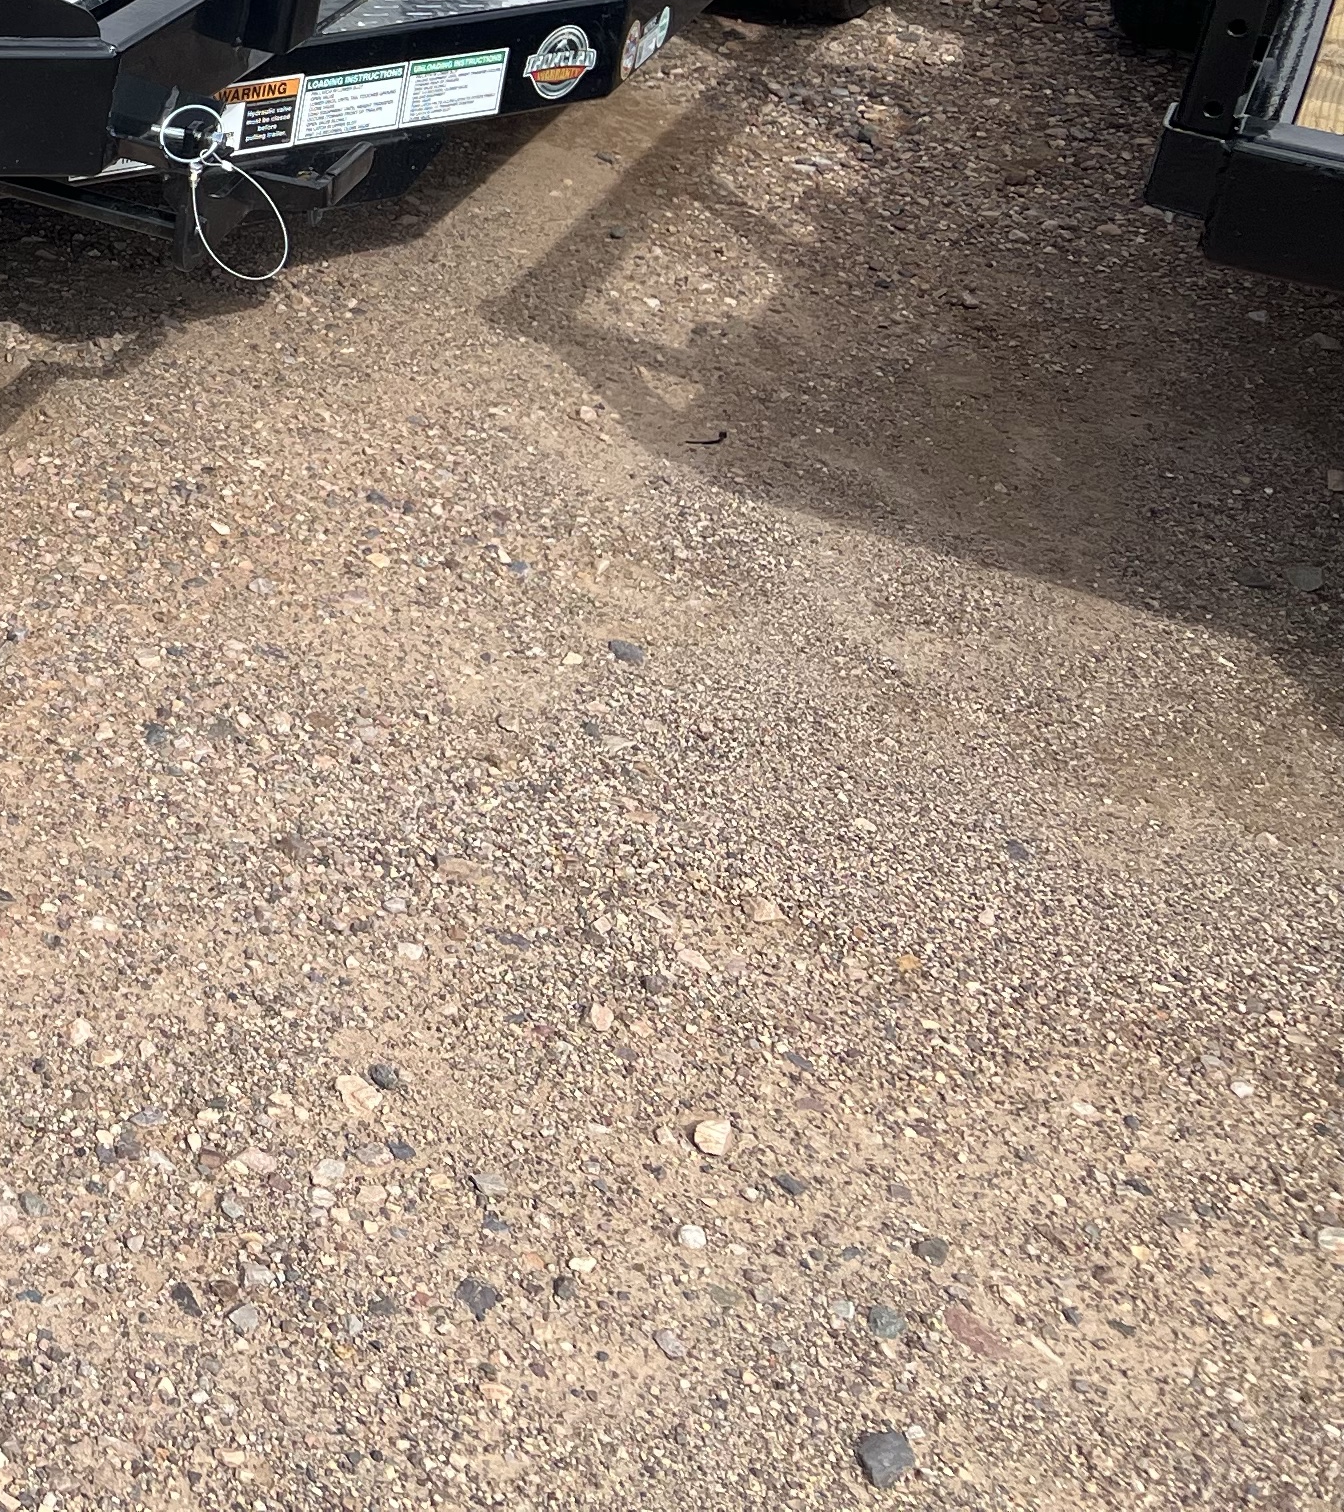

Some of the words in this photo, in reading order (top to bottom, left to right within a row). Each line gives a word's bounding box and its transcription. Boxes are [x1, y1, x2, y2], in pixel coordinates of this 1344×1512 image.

[413, 60, 452, 74] UNLOADING
[453, 53, 502, 68] INSTRUCTIONS
[307, 76, 343, 90] LOADING
[344, 69, 403, 85] INSTRUCTIONS
[537, 68, 581, 81] WARRANTY
[219, 82, 287, 102] WARNING
